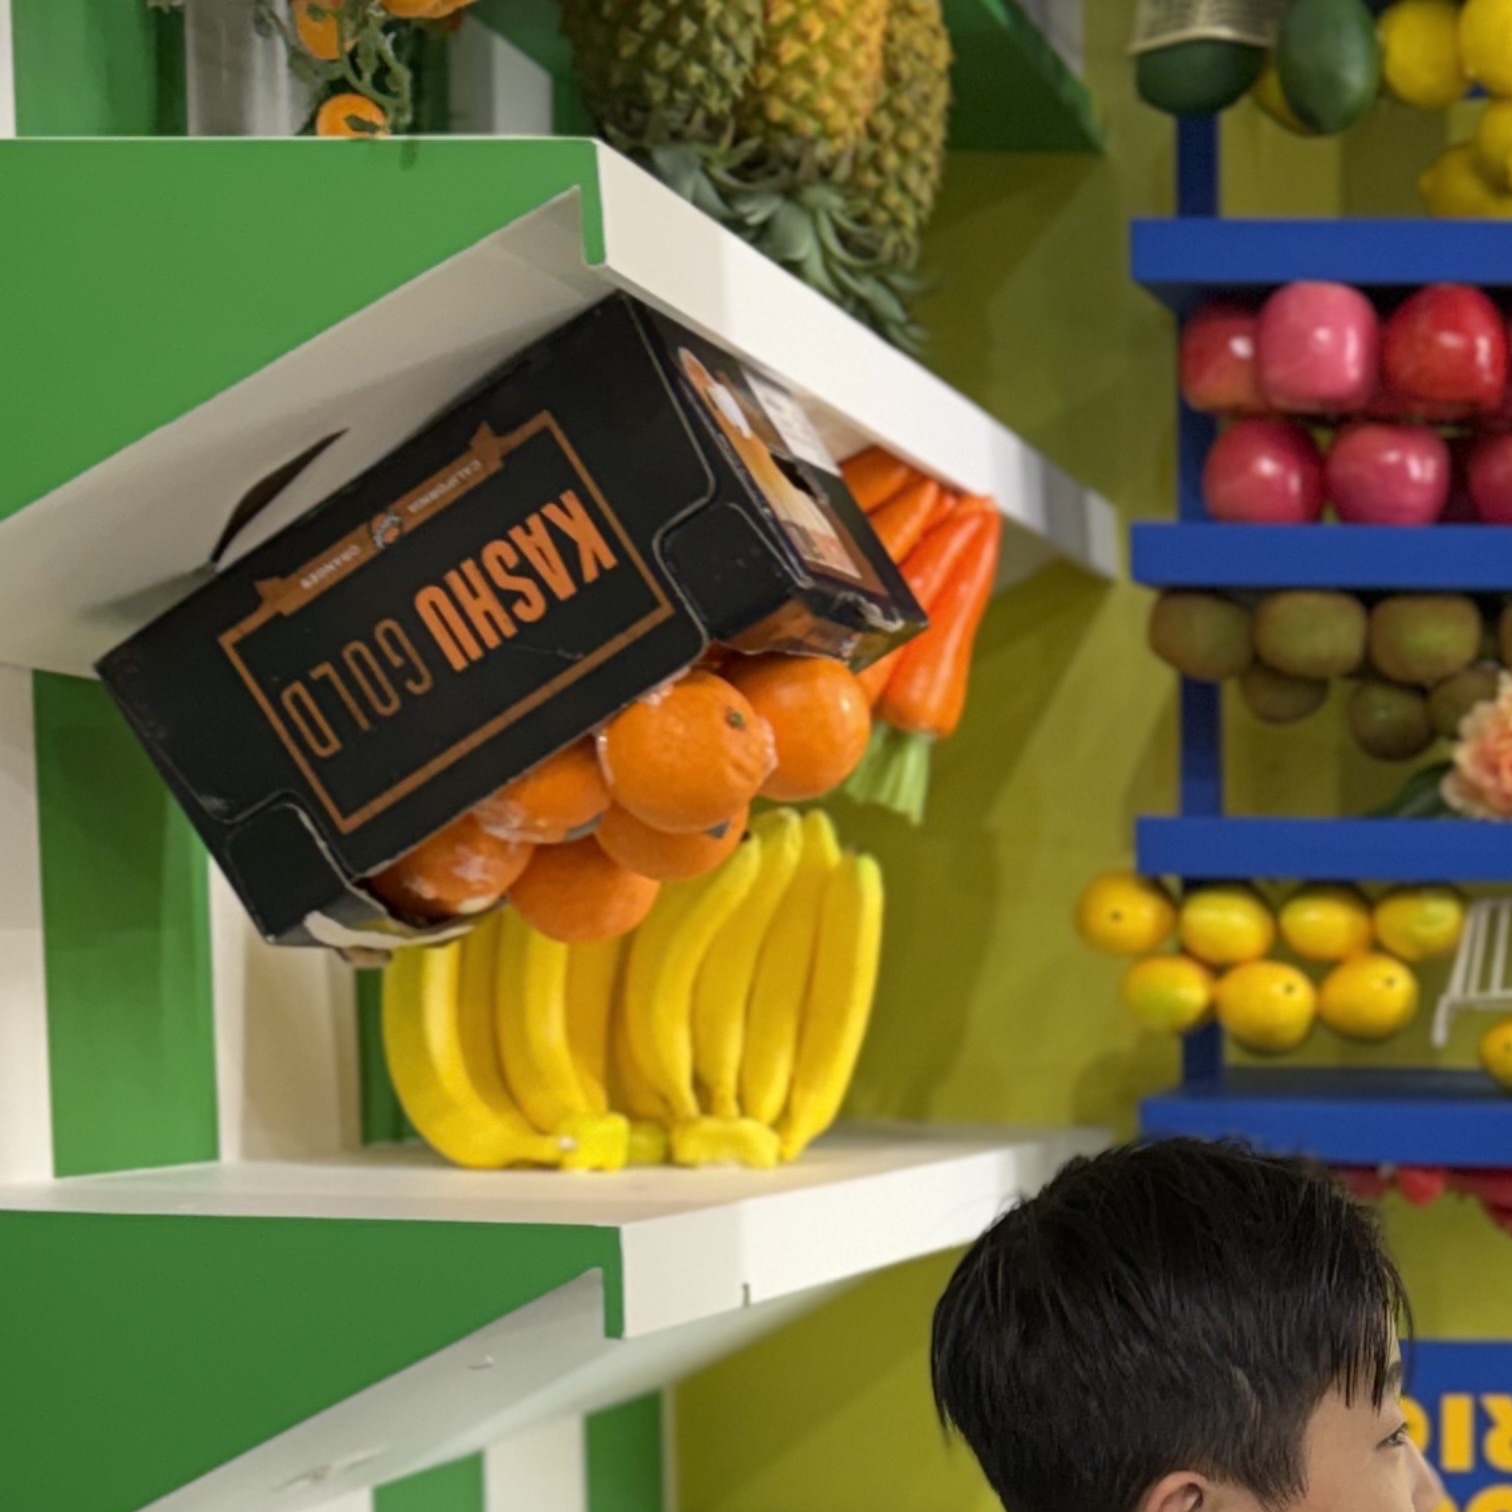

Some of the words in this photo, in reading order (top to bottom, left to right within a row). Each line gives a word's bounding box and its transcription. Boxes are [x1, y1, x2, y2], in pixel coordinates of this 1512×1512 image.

[406, 459, 483, 514] CALIFORNIA
[414, 489, 618, 673] KASHU
[280, 618, 434, 759] GOLD
